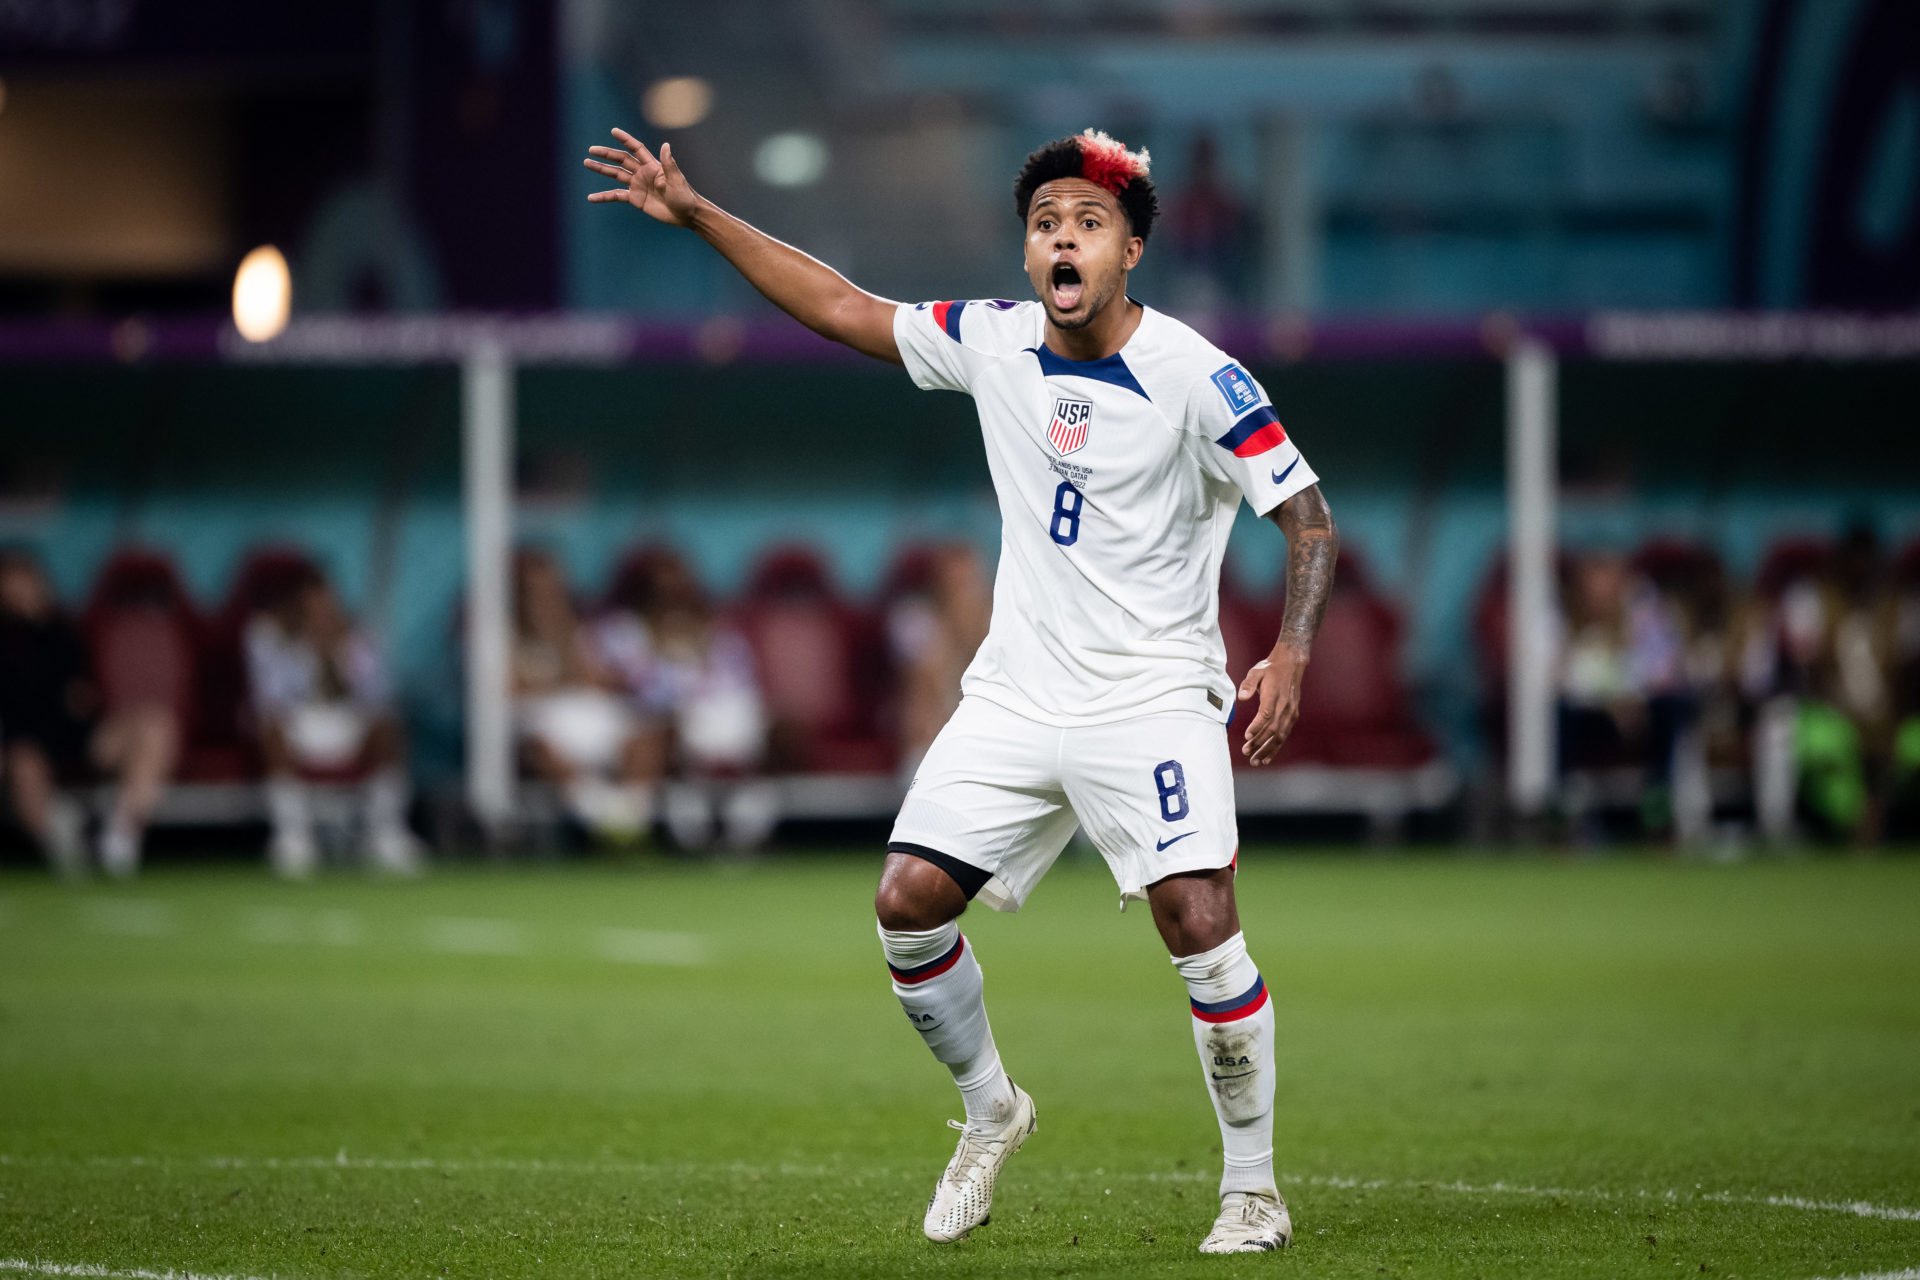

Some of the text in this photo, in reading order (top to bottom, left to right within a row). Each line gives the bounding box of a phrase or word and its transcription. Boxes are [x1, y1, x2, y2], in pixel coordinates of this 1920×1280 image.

[1058, 402, 1089, 425] USA
[1048, 456, 1072, 470] ERLANDS
[1082, 466, 1093, 474] USA
[1070, 471, 1088, 481] QATAR
[1050, 481, 1083, 546] 8
[1153, 760, 1189, 822] 8
[1213, 1056, 1250, 1066] USA
